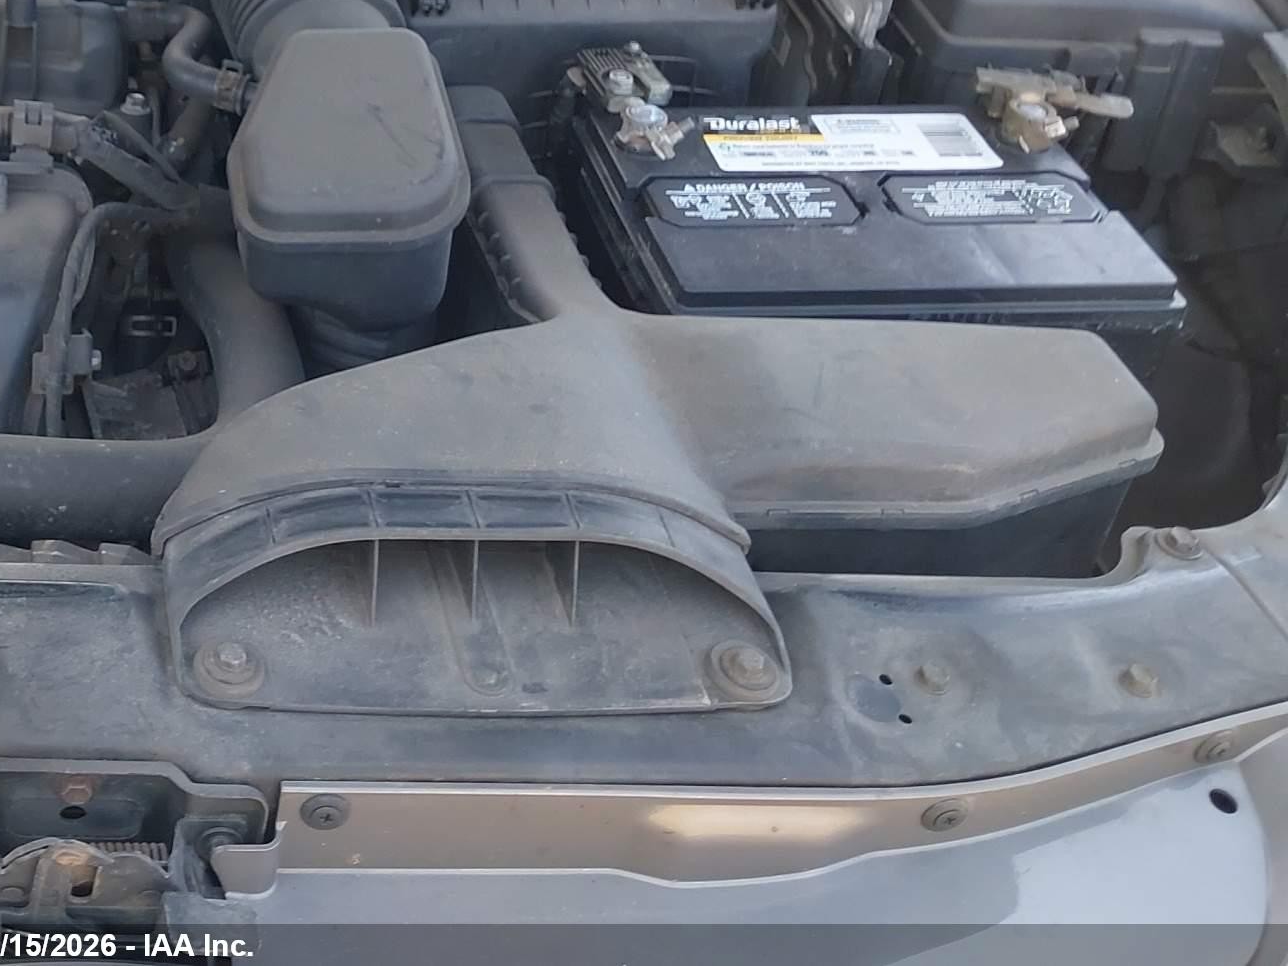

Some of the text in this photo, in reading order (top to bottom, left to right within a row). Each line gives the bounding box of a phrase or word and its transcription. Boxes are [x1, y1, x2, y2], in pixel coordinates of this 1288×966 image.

[703, 117, 800, 132] Duralast
[696, 184, 747, 193] DANGER
[758, 182, 805, 192] POISON
